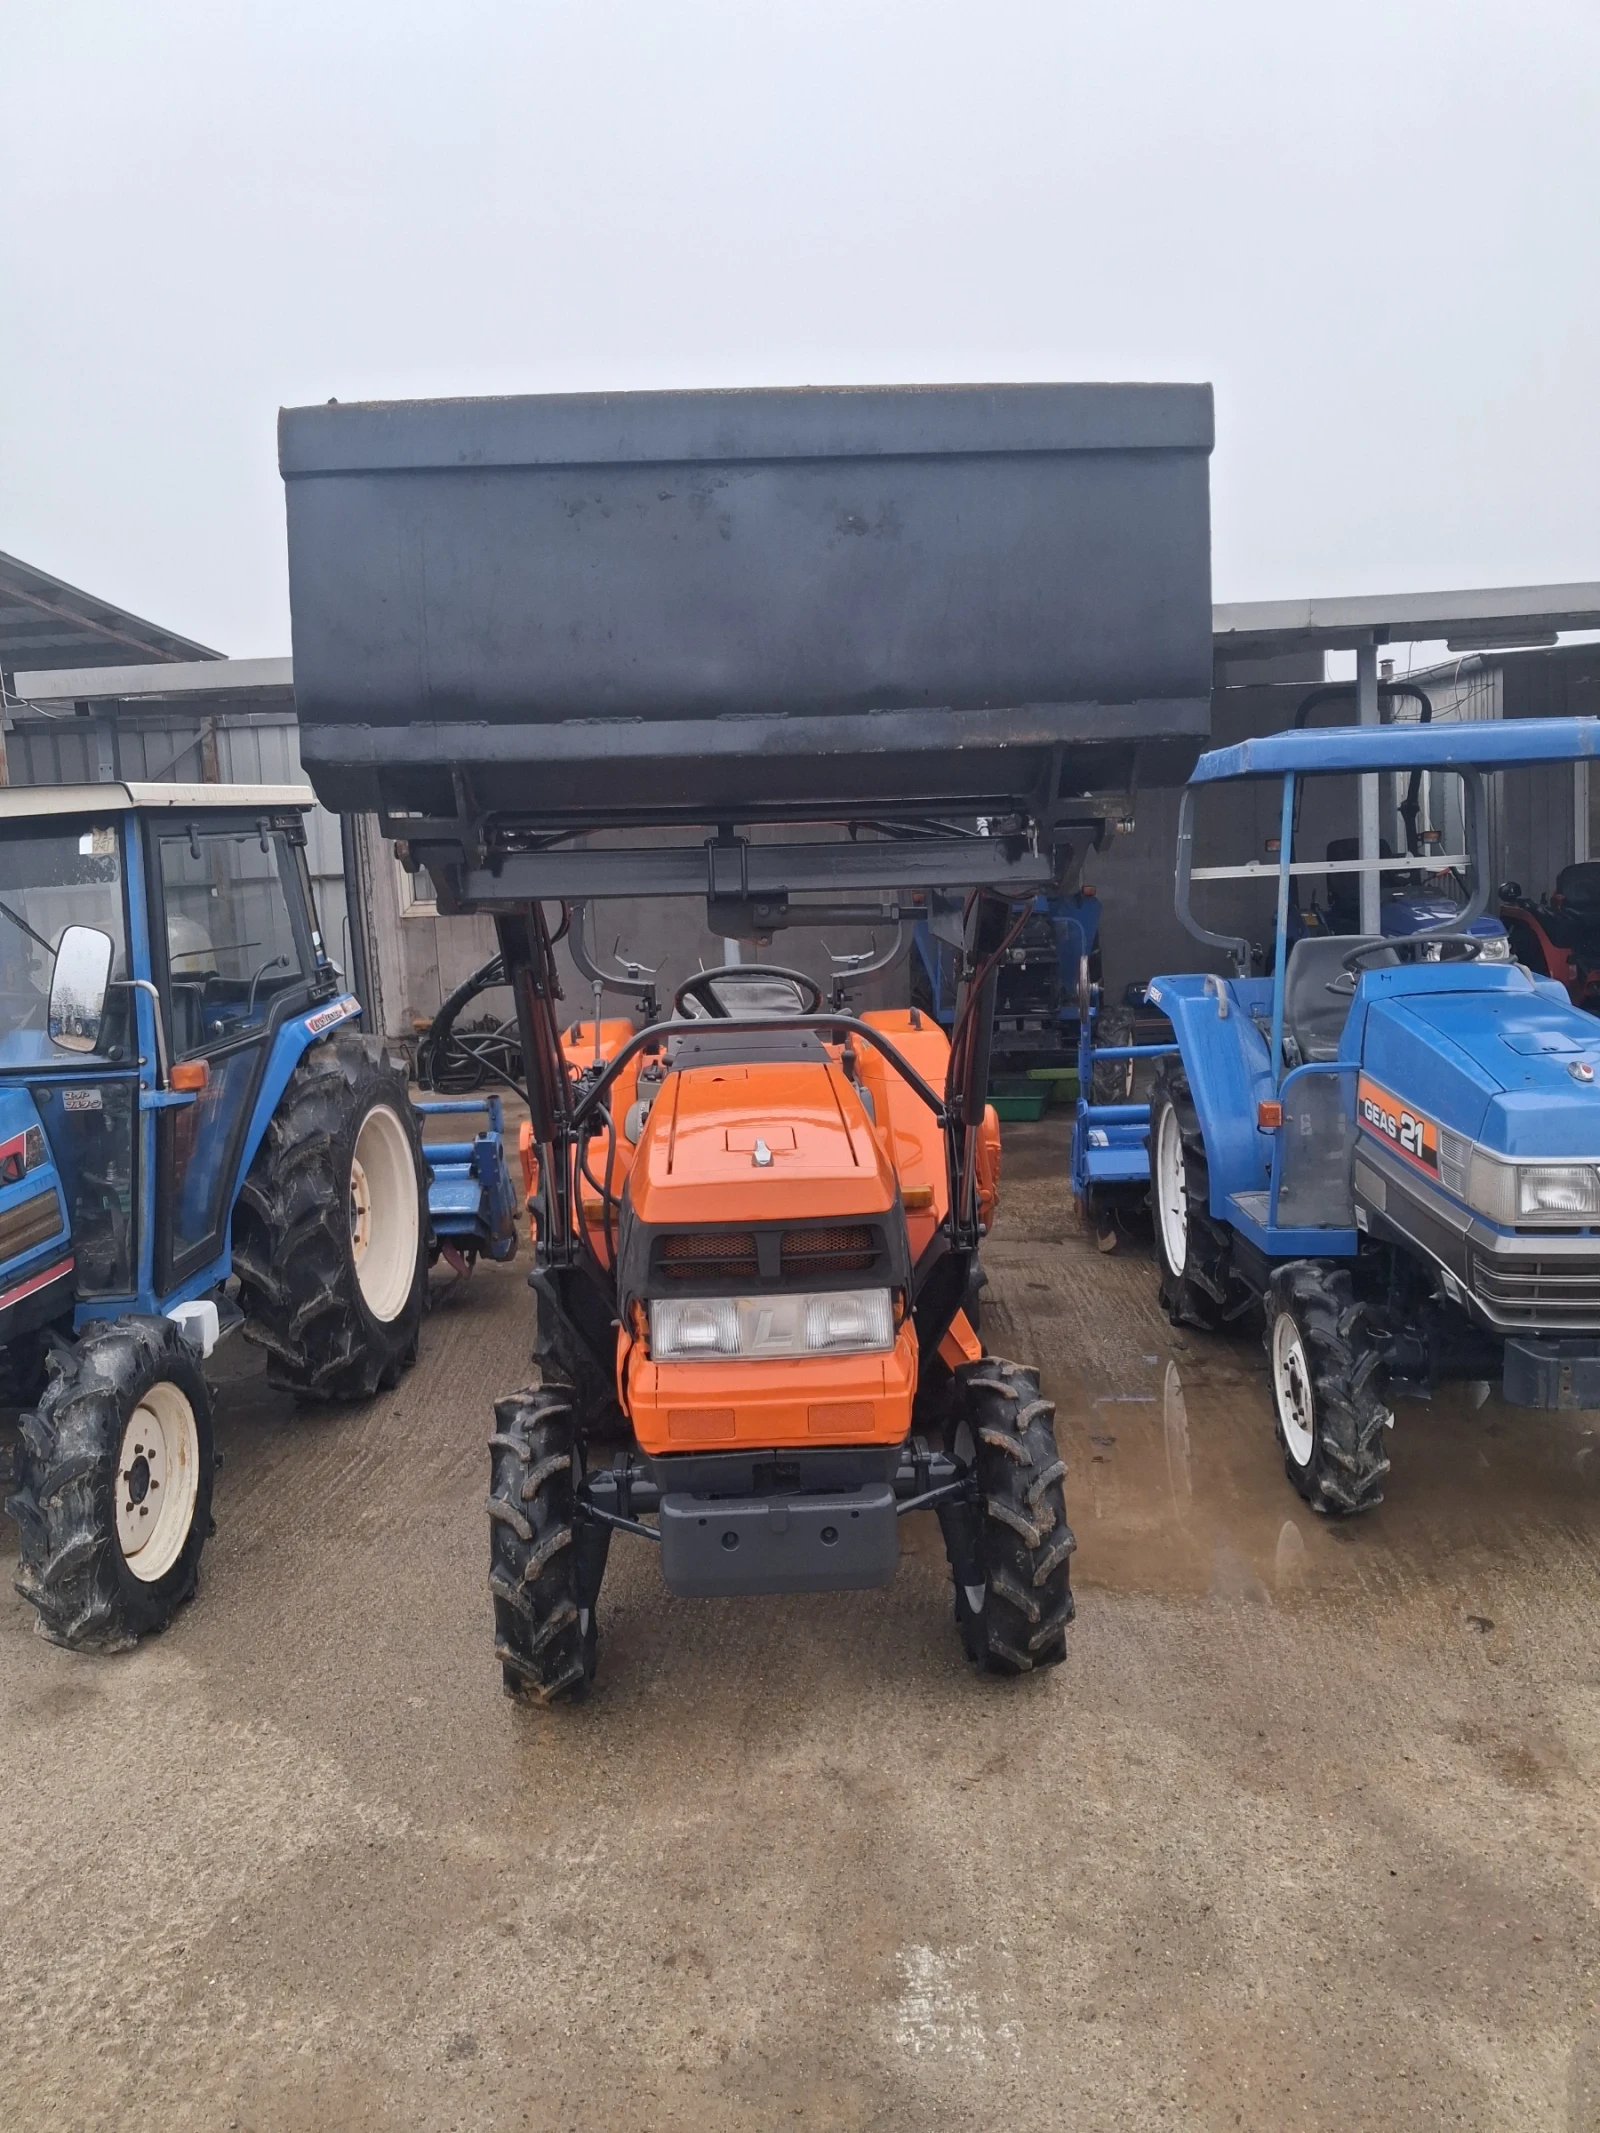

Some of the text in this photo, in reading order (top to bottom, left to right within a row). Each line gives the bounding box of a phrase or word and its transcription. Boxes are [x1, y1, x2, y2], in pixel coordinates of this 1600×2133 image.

[1364, 1097, 1397, 1140] GEAS
[1400, 1110, 1424, 1159] 21
[752, 1309, 793, 1349] L
